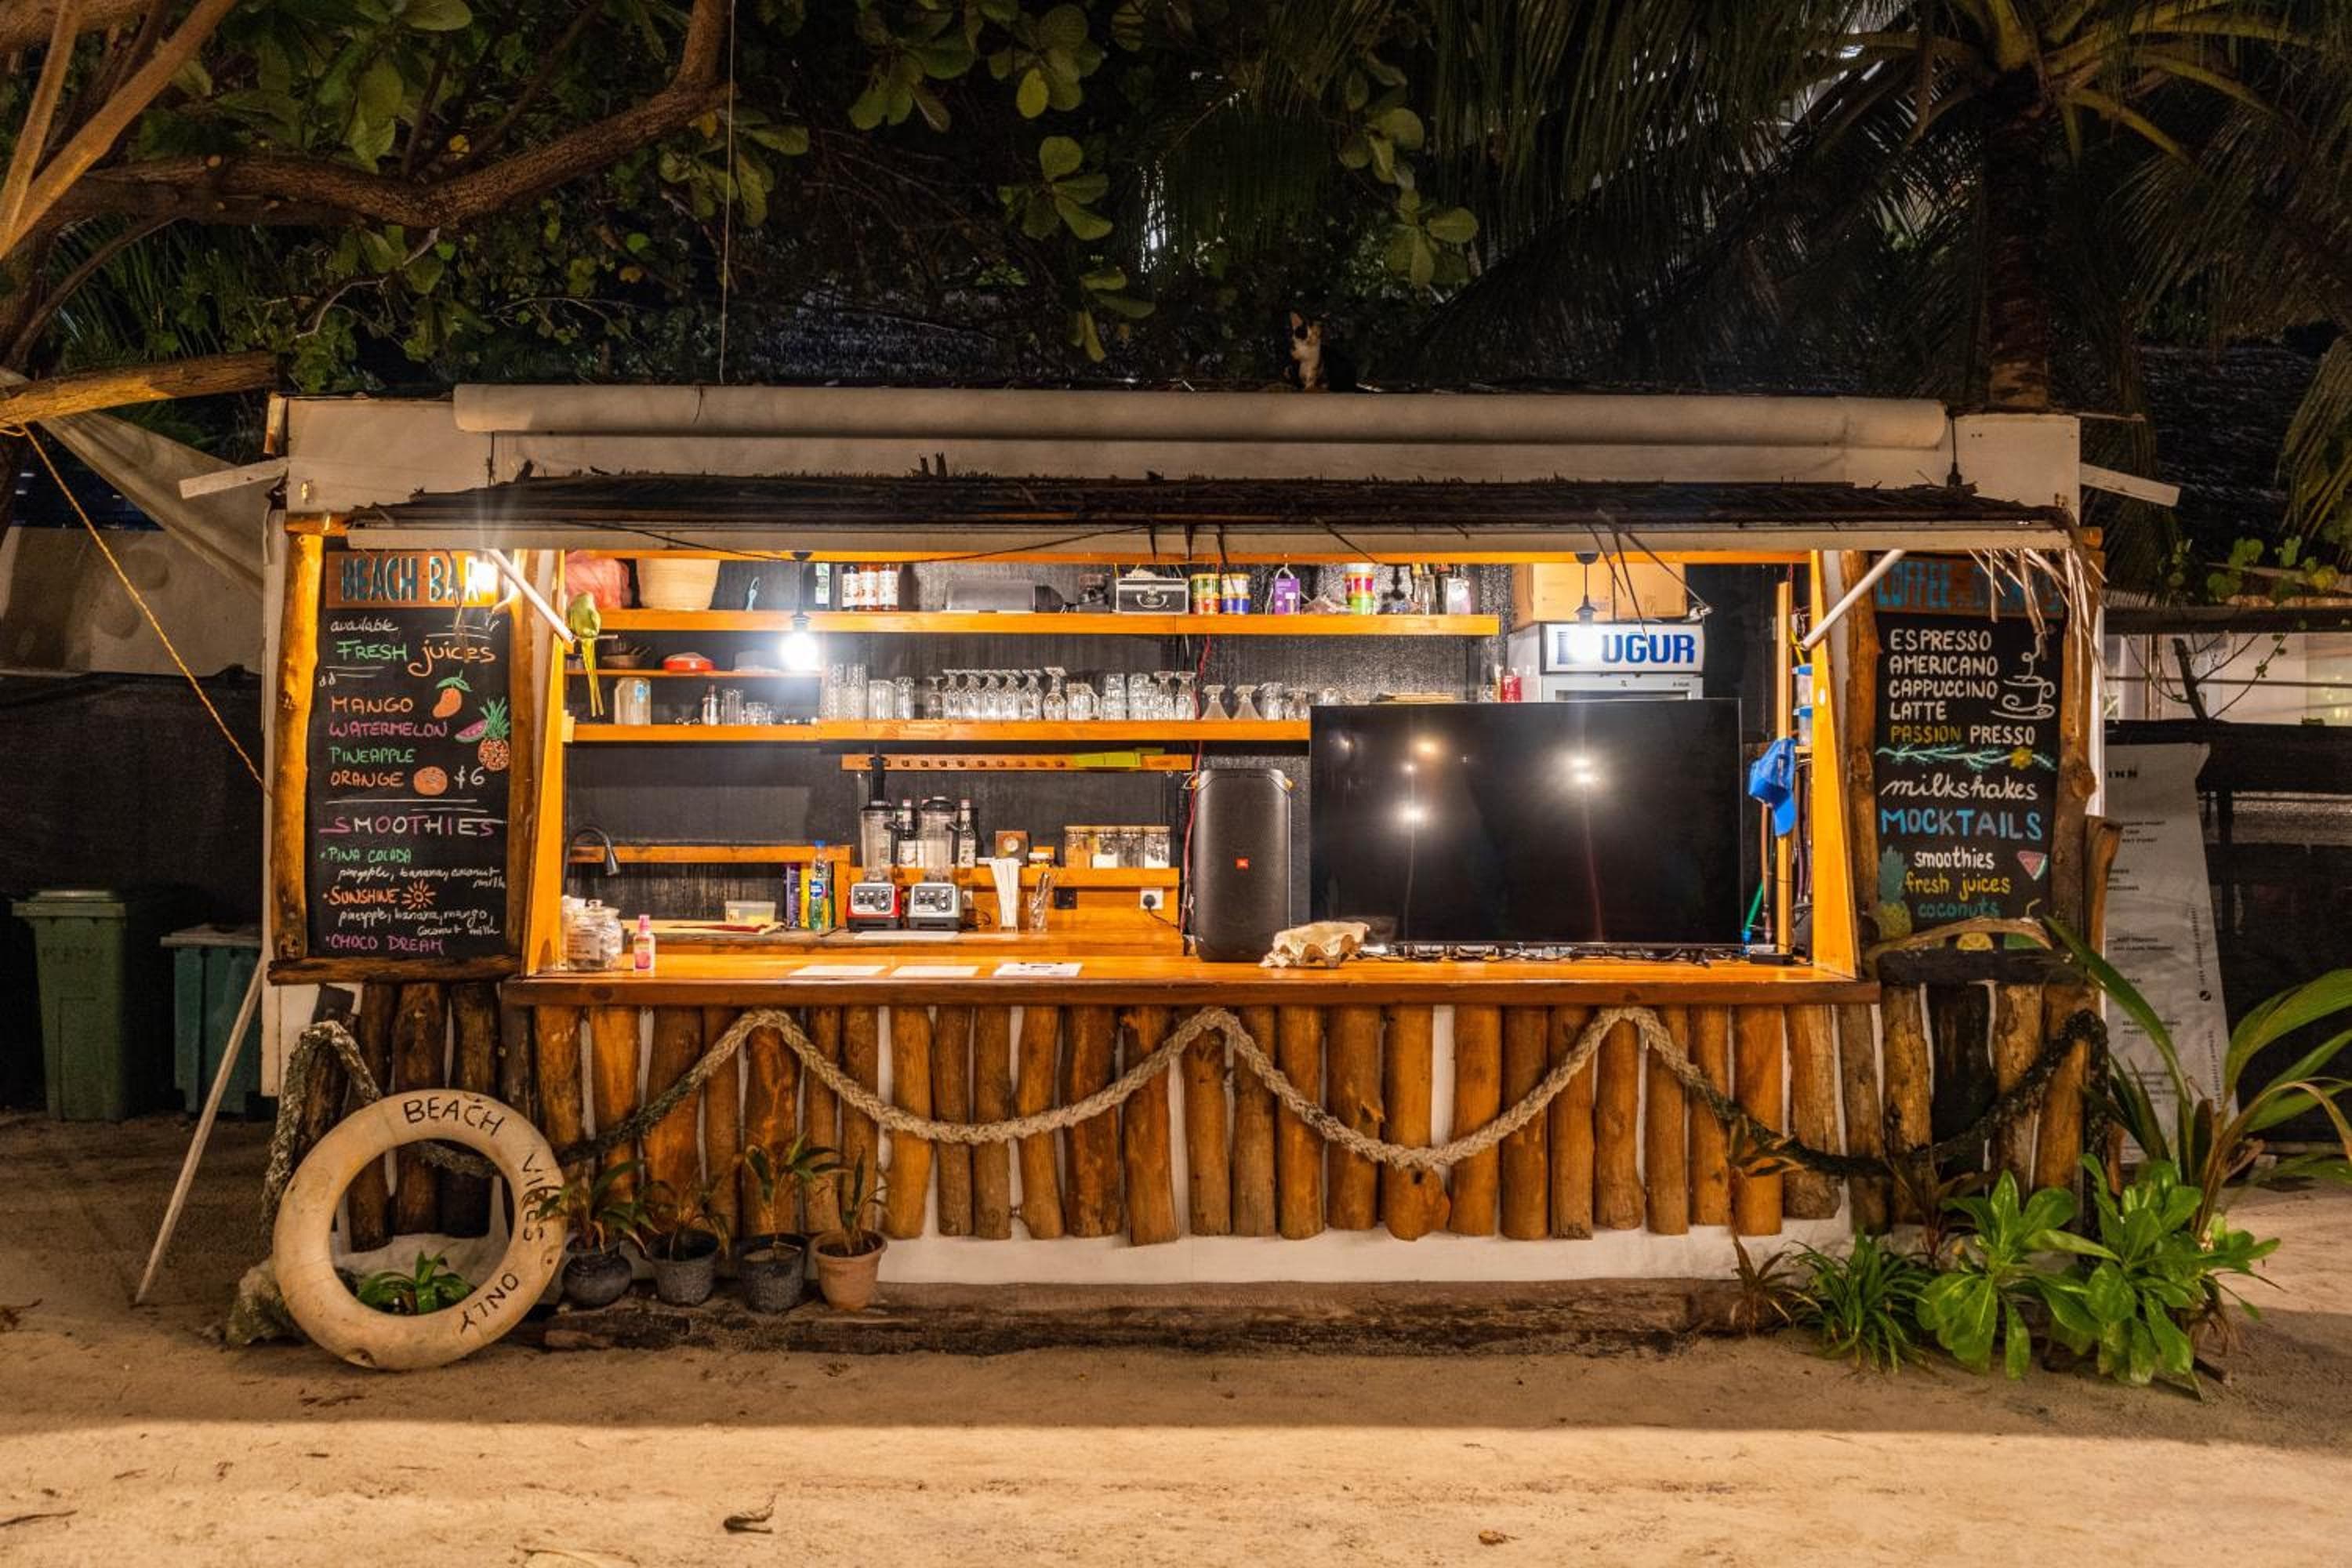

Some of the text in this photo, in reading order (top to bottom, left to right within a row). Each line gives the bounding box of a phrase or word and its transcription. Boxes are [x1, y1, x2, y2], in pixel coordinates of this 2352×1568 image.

[341, 556, 418, 602] BEACH
[1889, 629, 1992, 652] ESPRESSO
[336, 640, 496, 677] FRESH juices
[1889, 655, 1998, 676] AMERICANO
[1888, 680, 1998, 699] CAPPUCCINO
[331, 696, 413, 714] MANGO
[1889, 702, 1947, 721] LATTE
[328, 720, 448, 737] WATERMELON
[1890, 725, 2036, 745] PASSION PRESSO
[329, 747, 416, 763] PINEAPPLE
[329, 770, 405, 788] ORANGE
[1881, 773, 2038, 800] milkshakes
[318, 815, 506, 837] SMOOTHIES
[1881, 808, 2042, 840] MOCKTAILS
[368, 848, 412, 863] COLADA
[1914, 846, 1995, 869] smoothies
[1905, 872, 2011, 901] fresh juices
[1918, 899, 1999, 918] coconuts
[330, 935, 445, 955] CHOCO DREAM
[403, 1097, 506, 1137] BEACH
[459, 1272, 519, 1334] ONLY
